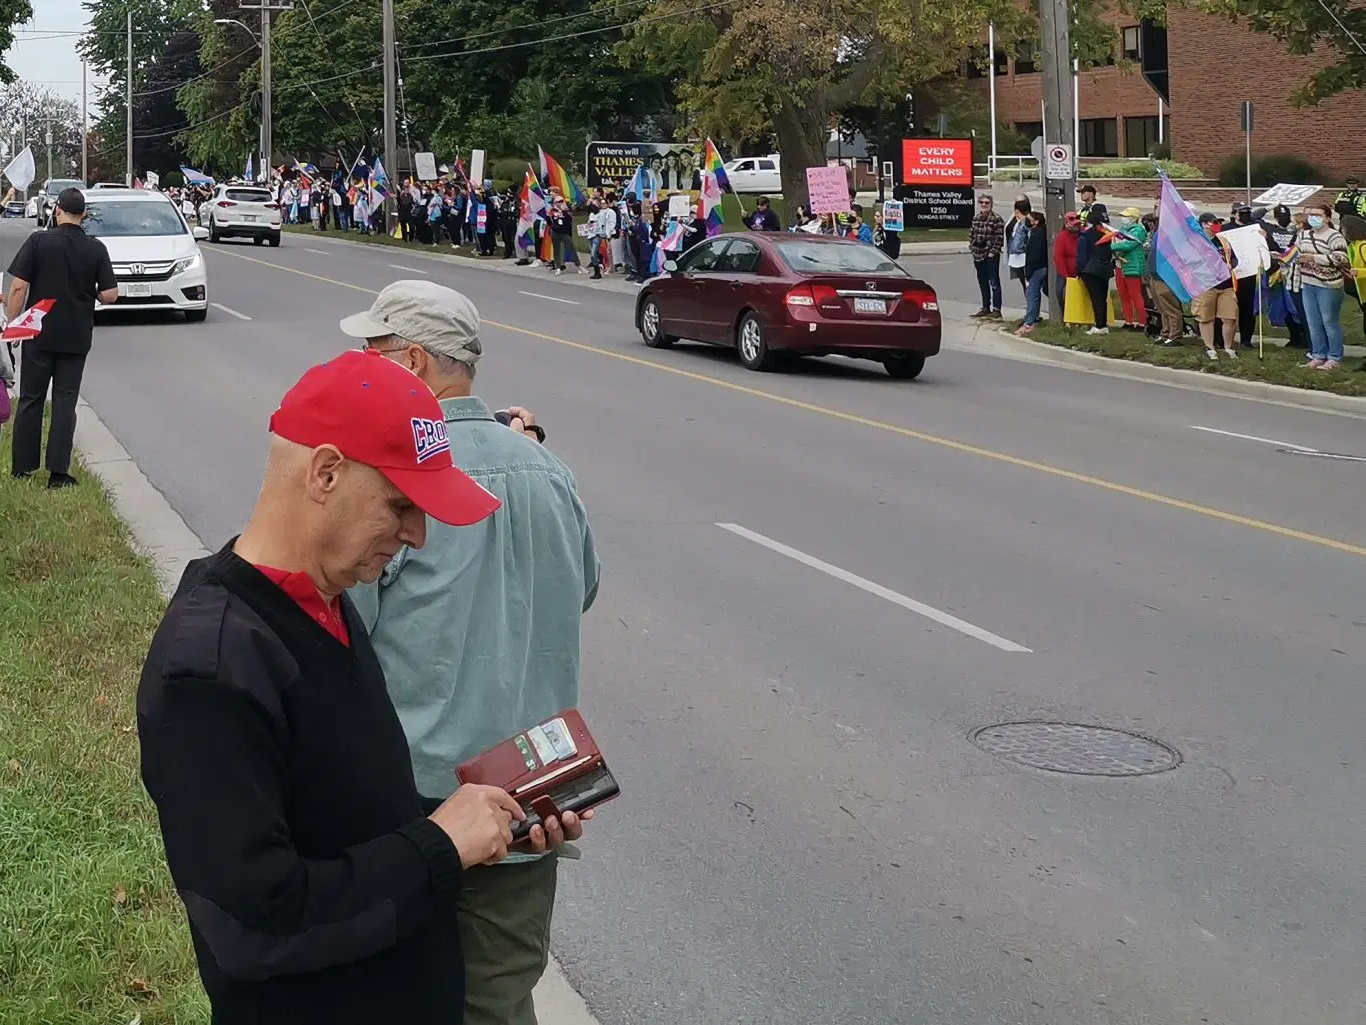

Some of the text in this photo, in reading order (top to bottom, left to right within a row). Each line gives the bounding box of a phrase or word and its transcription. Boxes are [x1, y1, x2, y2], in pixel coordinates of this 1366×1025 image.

[597, 147, 639, 156] Where will
[918, 147, 955, 156] EVERY
[593, 156, 644, 166] THAMES
[920, 157, 955, 165] CHILD
[911, 167, 963, 176] MATTERS
[942, 191, 962, 199] Valley
[903, 197, 927, 205] District
[928, 197, 952, 205] School
[930, 206, 947, 214] 1250
[411, 417, 450, 455] CRO
